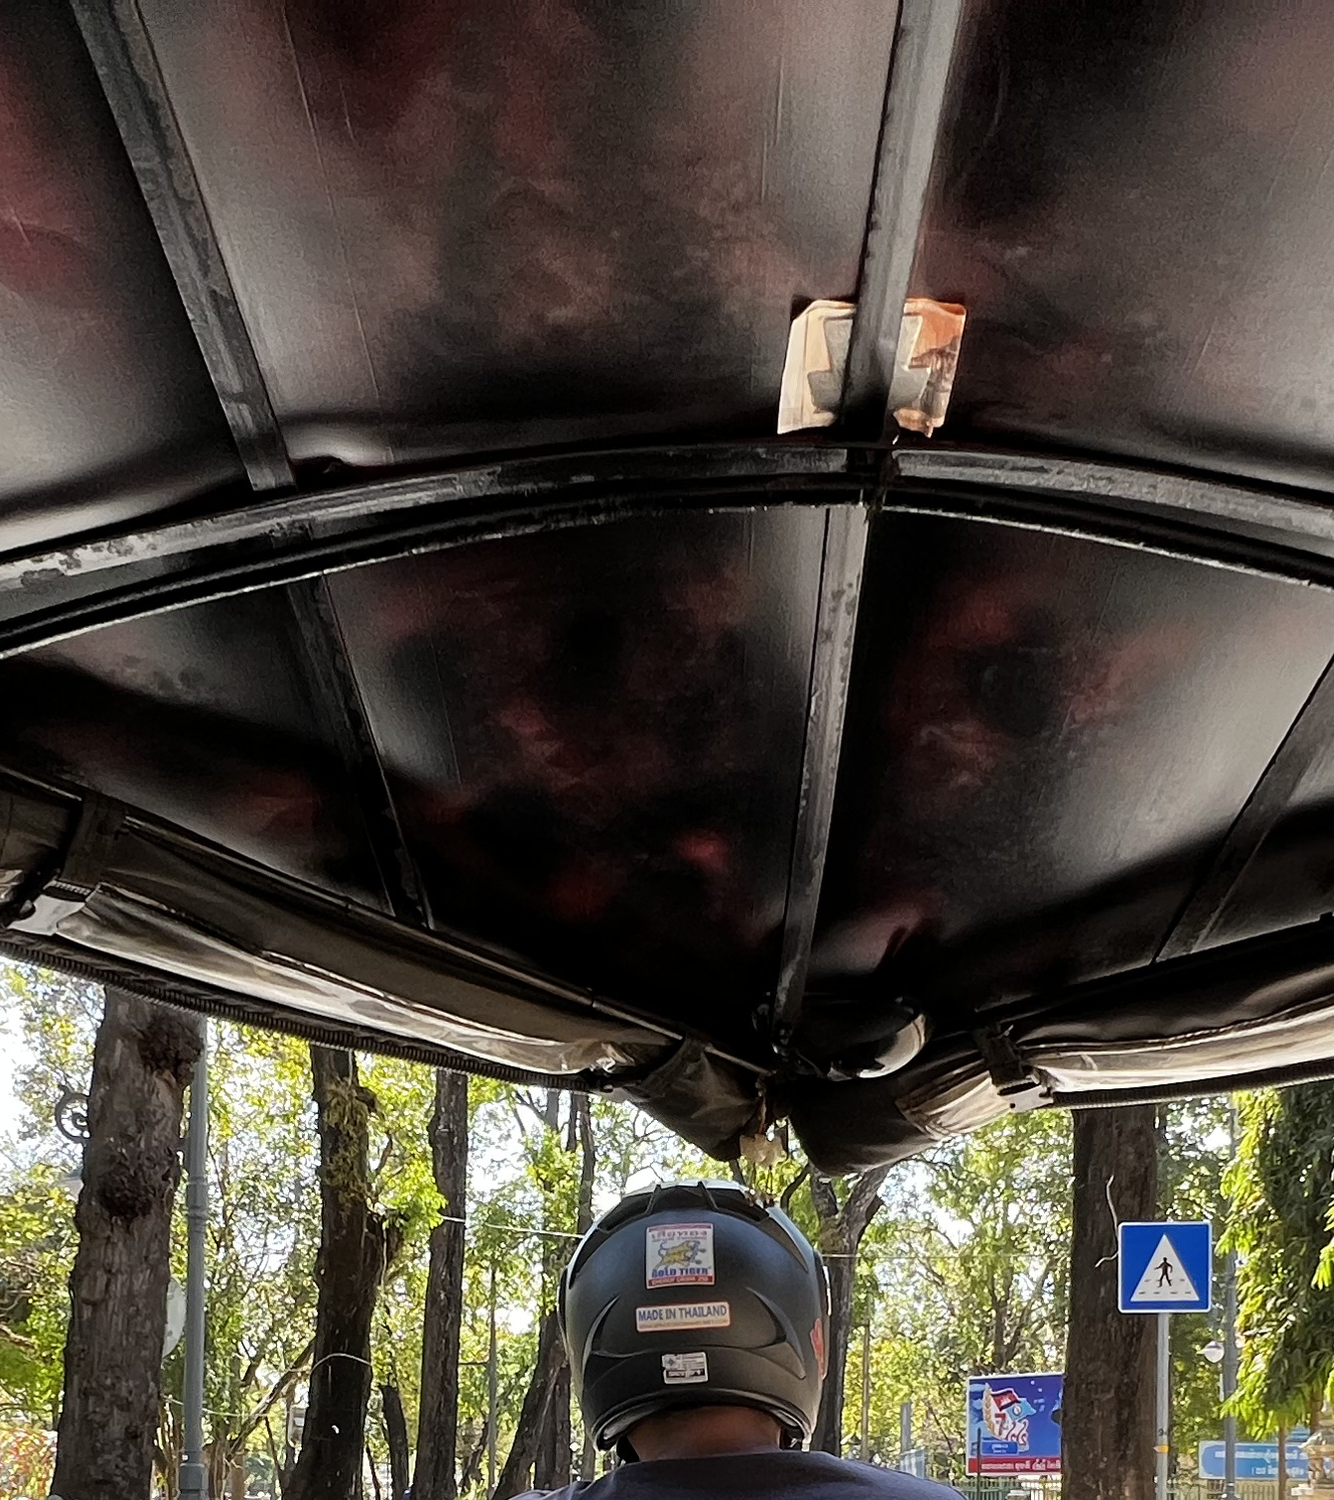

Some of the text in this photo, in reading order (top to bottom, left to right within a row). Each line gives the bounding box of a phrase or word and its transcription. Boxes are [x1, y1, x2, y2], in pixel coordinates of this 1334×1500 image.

[639, 1305, 727, 1322] MADE IN THAILAND
